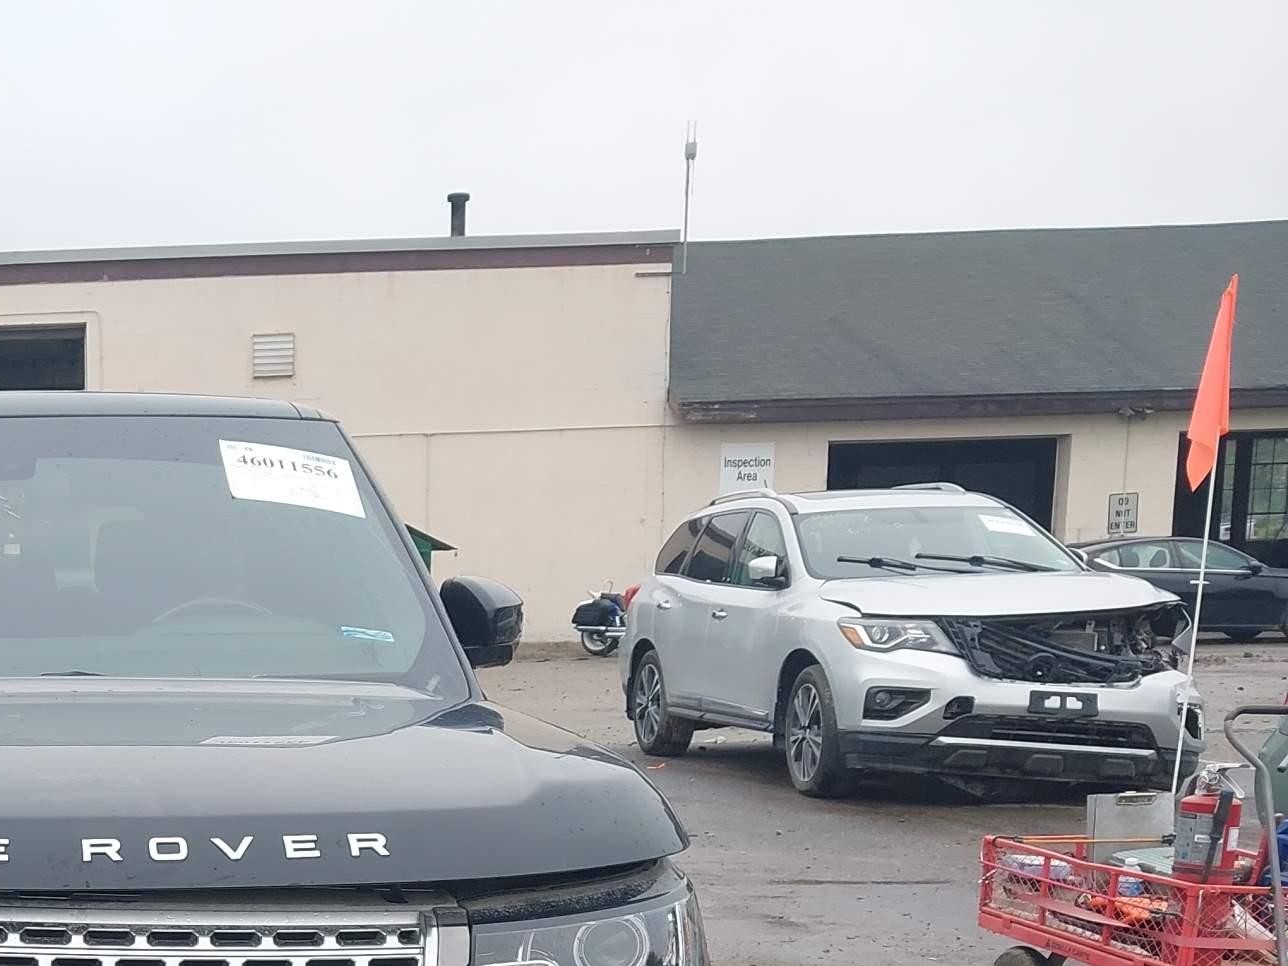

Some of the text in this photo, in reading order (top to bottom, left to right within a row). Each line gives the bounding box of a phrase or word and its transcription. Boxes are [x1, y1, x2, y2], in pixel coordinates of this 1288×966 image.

[237, 454, 338, 479] 46011556
[724, 456, 771, 470] Inspection
[736, 470, 758, 481] Area
[81, 833, 391, 863] ROVER
